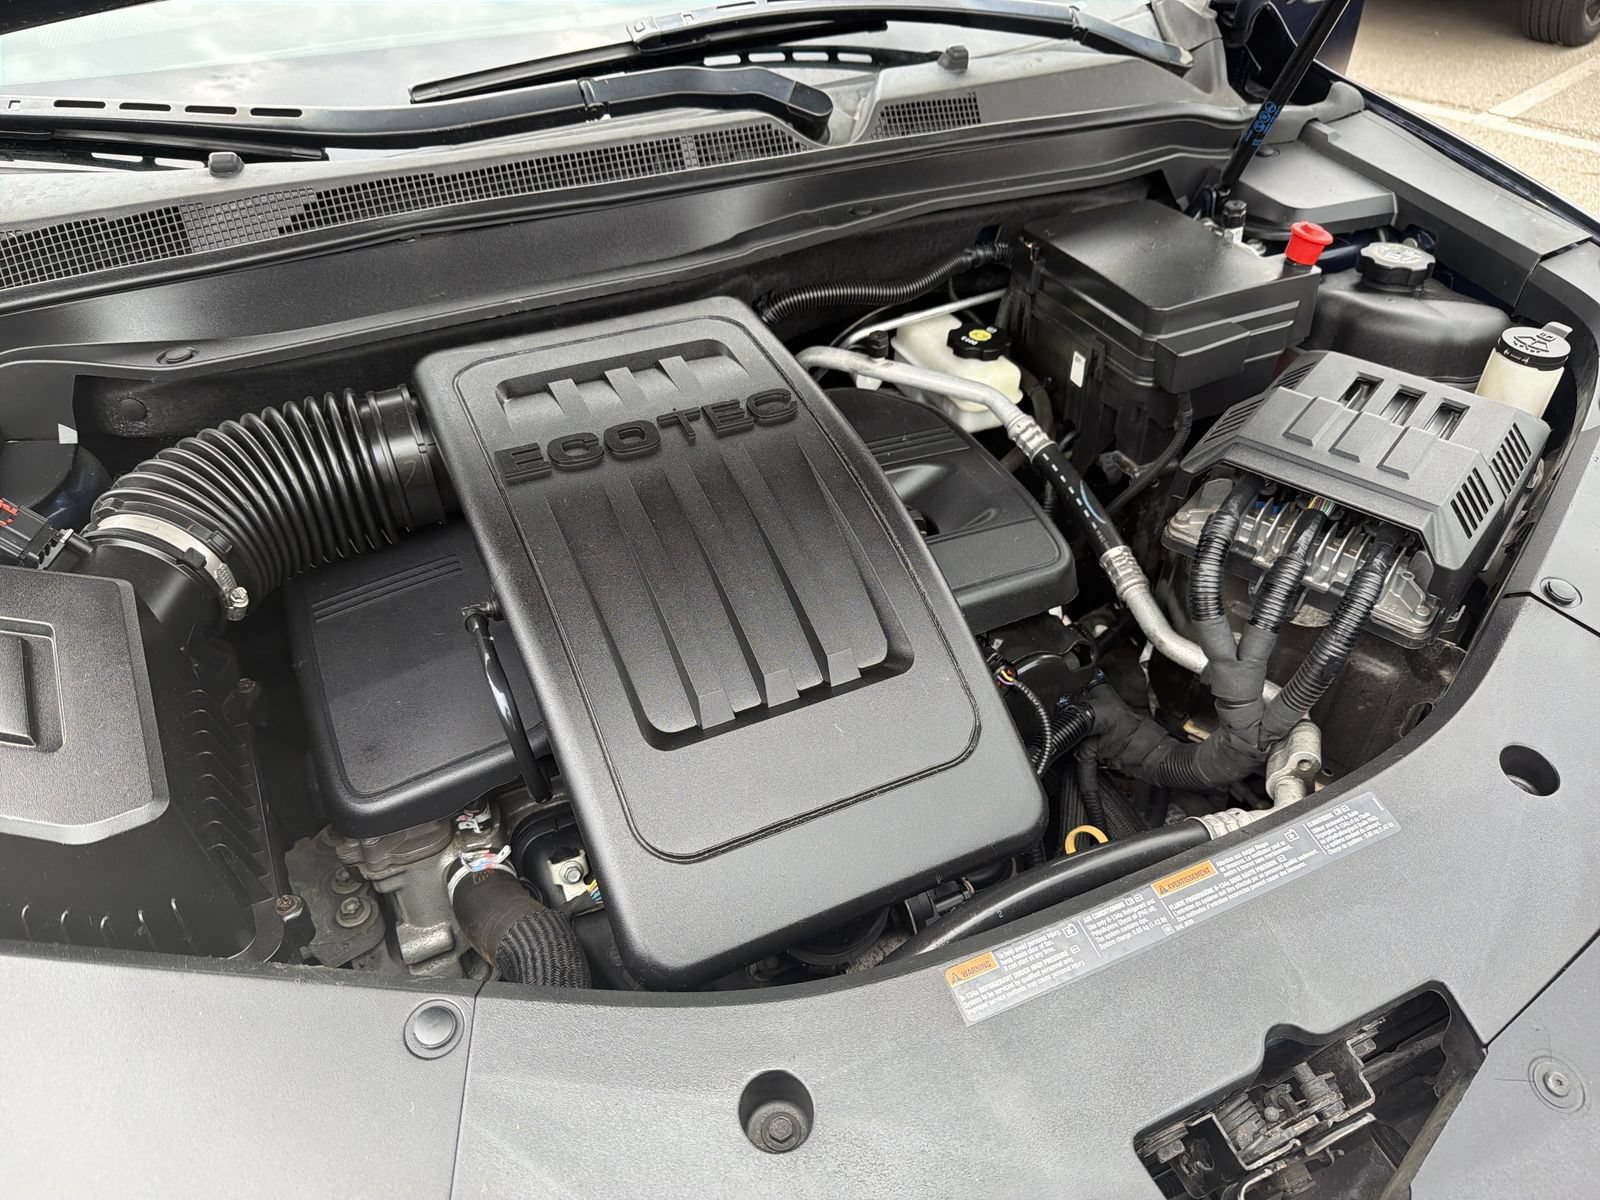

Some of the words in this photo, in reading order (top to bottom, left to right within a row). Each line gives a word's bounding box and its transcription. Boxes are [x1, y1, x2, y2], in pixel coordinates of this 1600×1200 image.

[494, 388, 798, 485] ECOTEC
[1167, 867, 1212, 890] AVERTISSEMENT
[961, 959, 992, 979] WARNING
